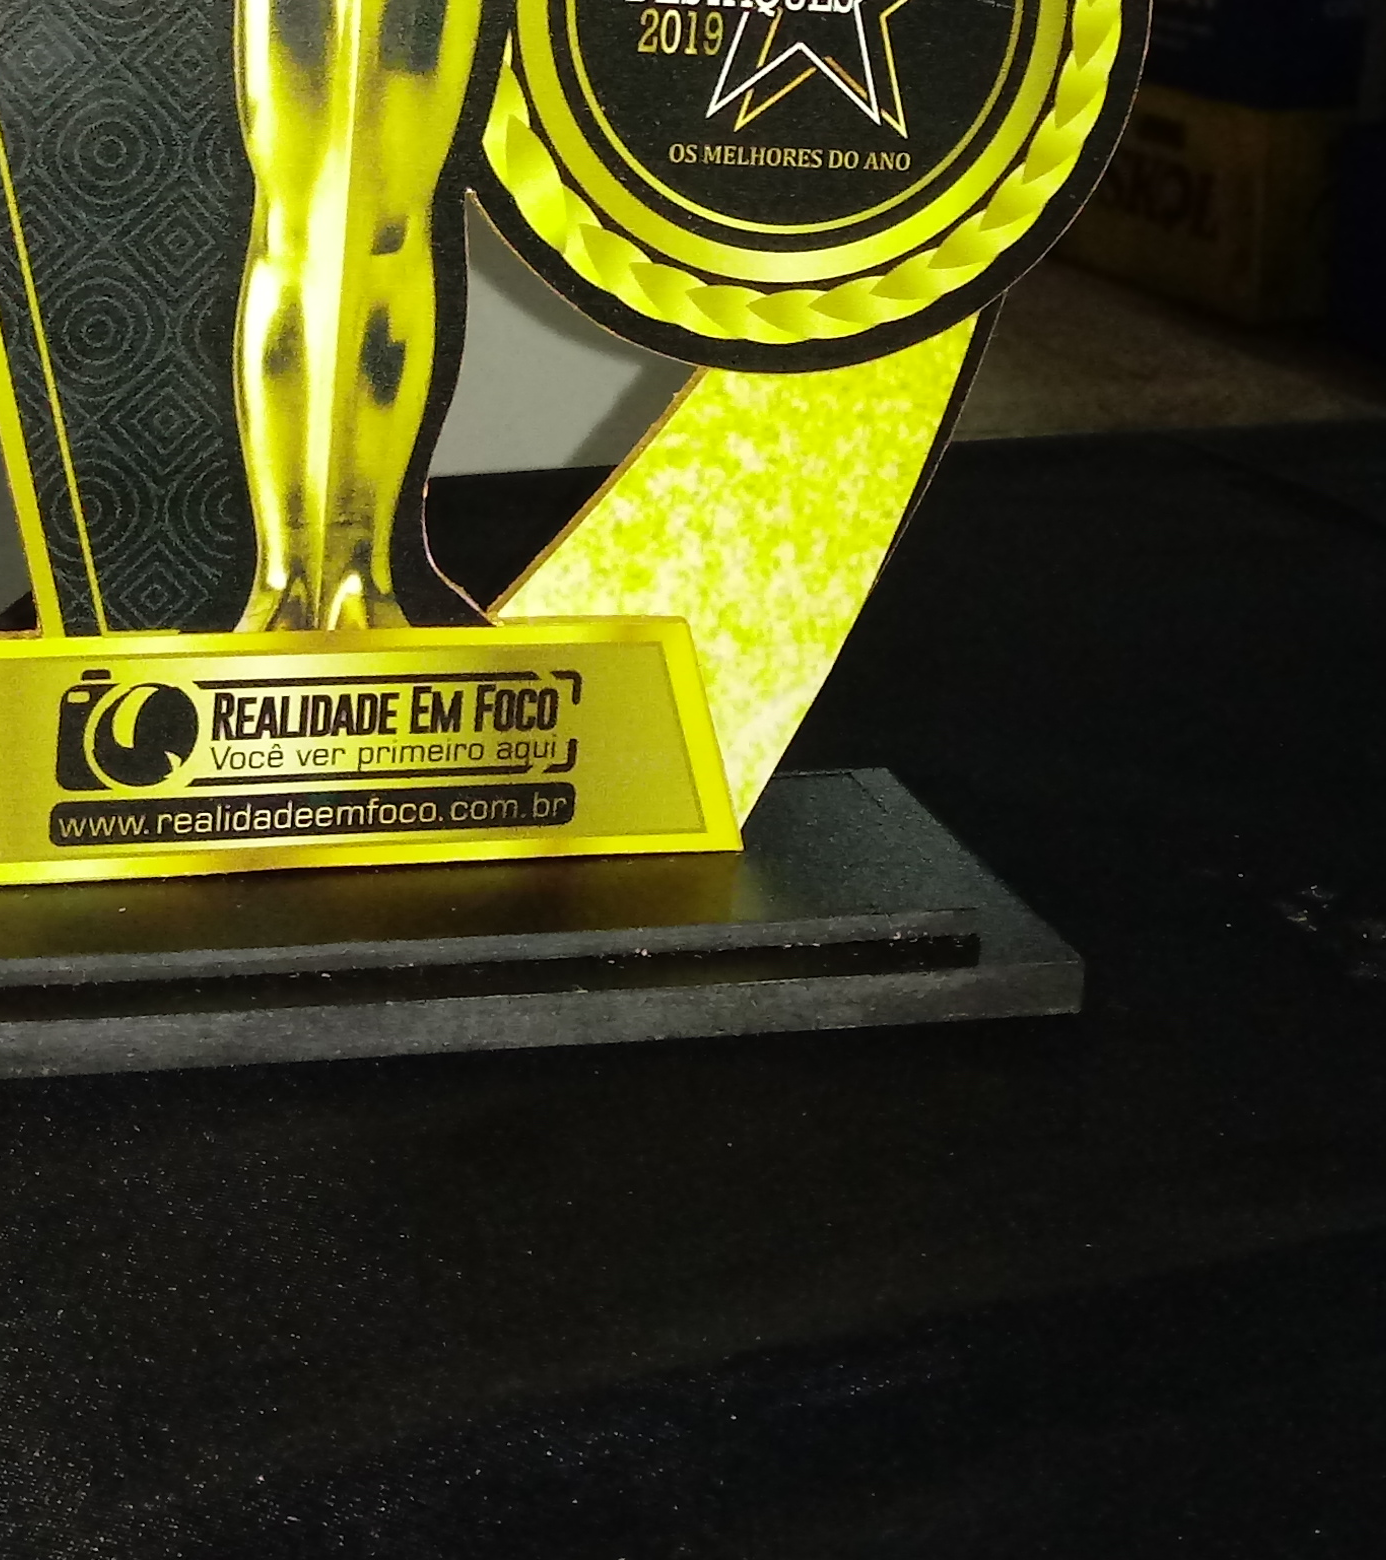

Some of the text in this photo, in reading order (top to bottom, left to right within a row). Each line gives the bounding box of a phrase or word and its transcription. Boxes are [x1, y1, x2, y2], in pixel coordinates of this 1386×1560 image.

[636, 8, 724, 57] 2019
[669, 144, 912, 172] OS MELHORES DO ANO
[211, 733, 559, 771] Você ver primeiro aqui
[58, 790, 569, 838] www.realidadeemfoco.com.br
